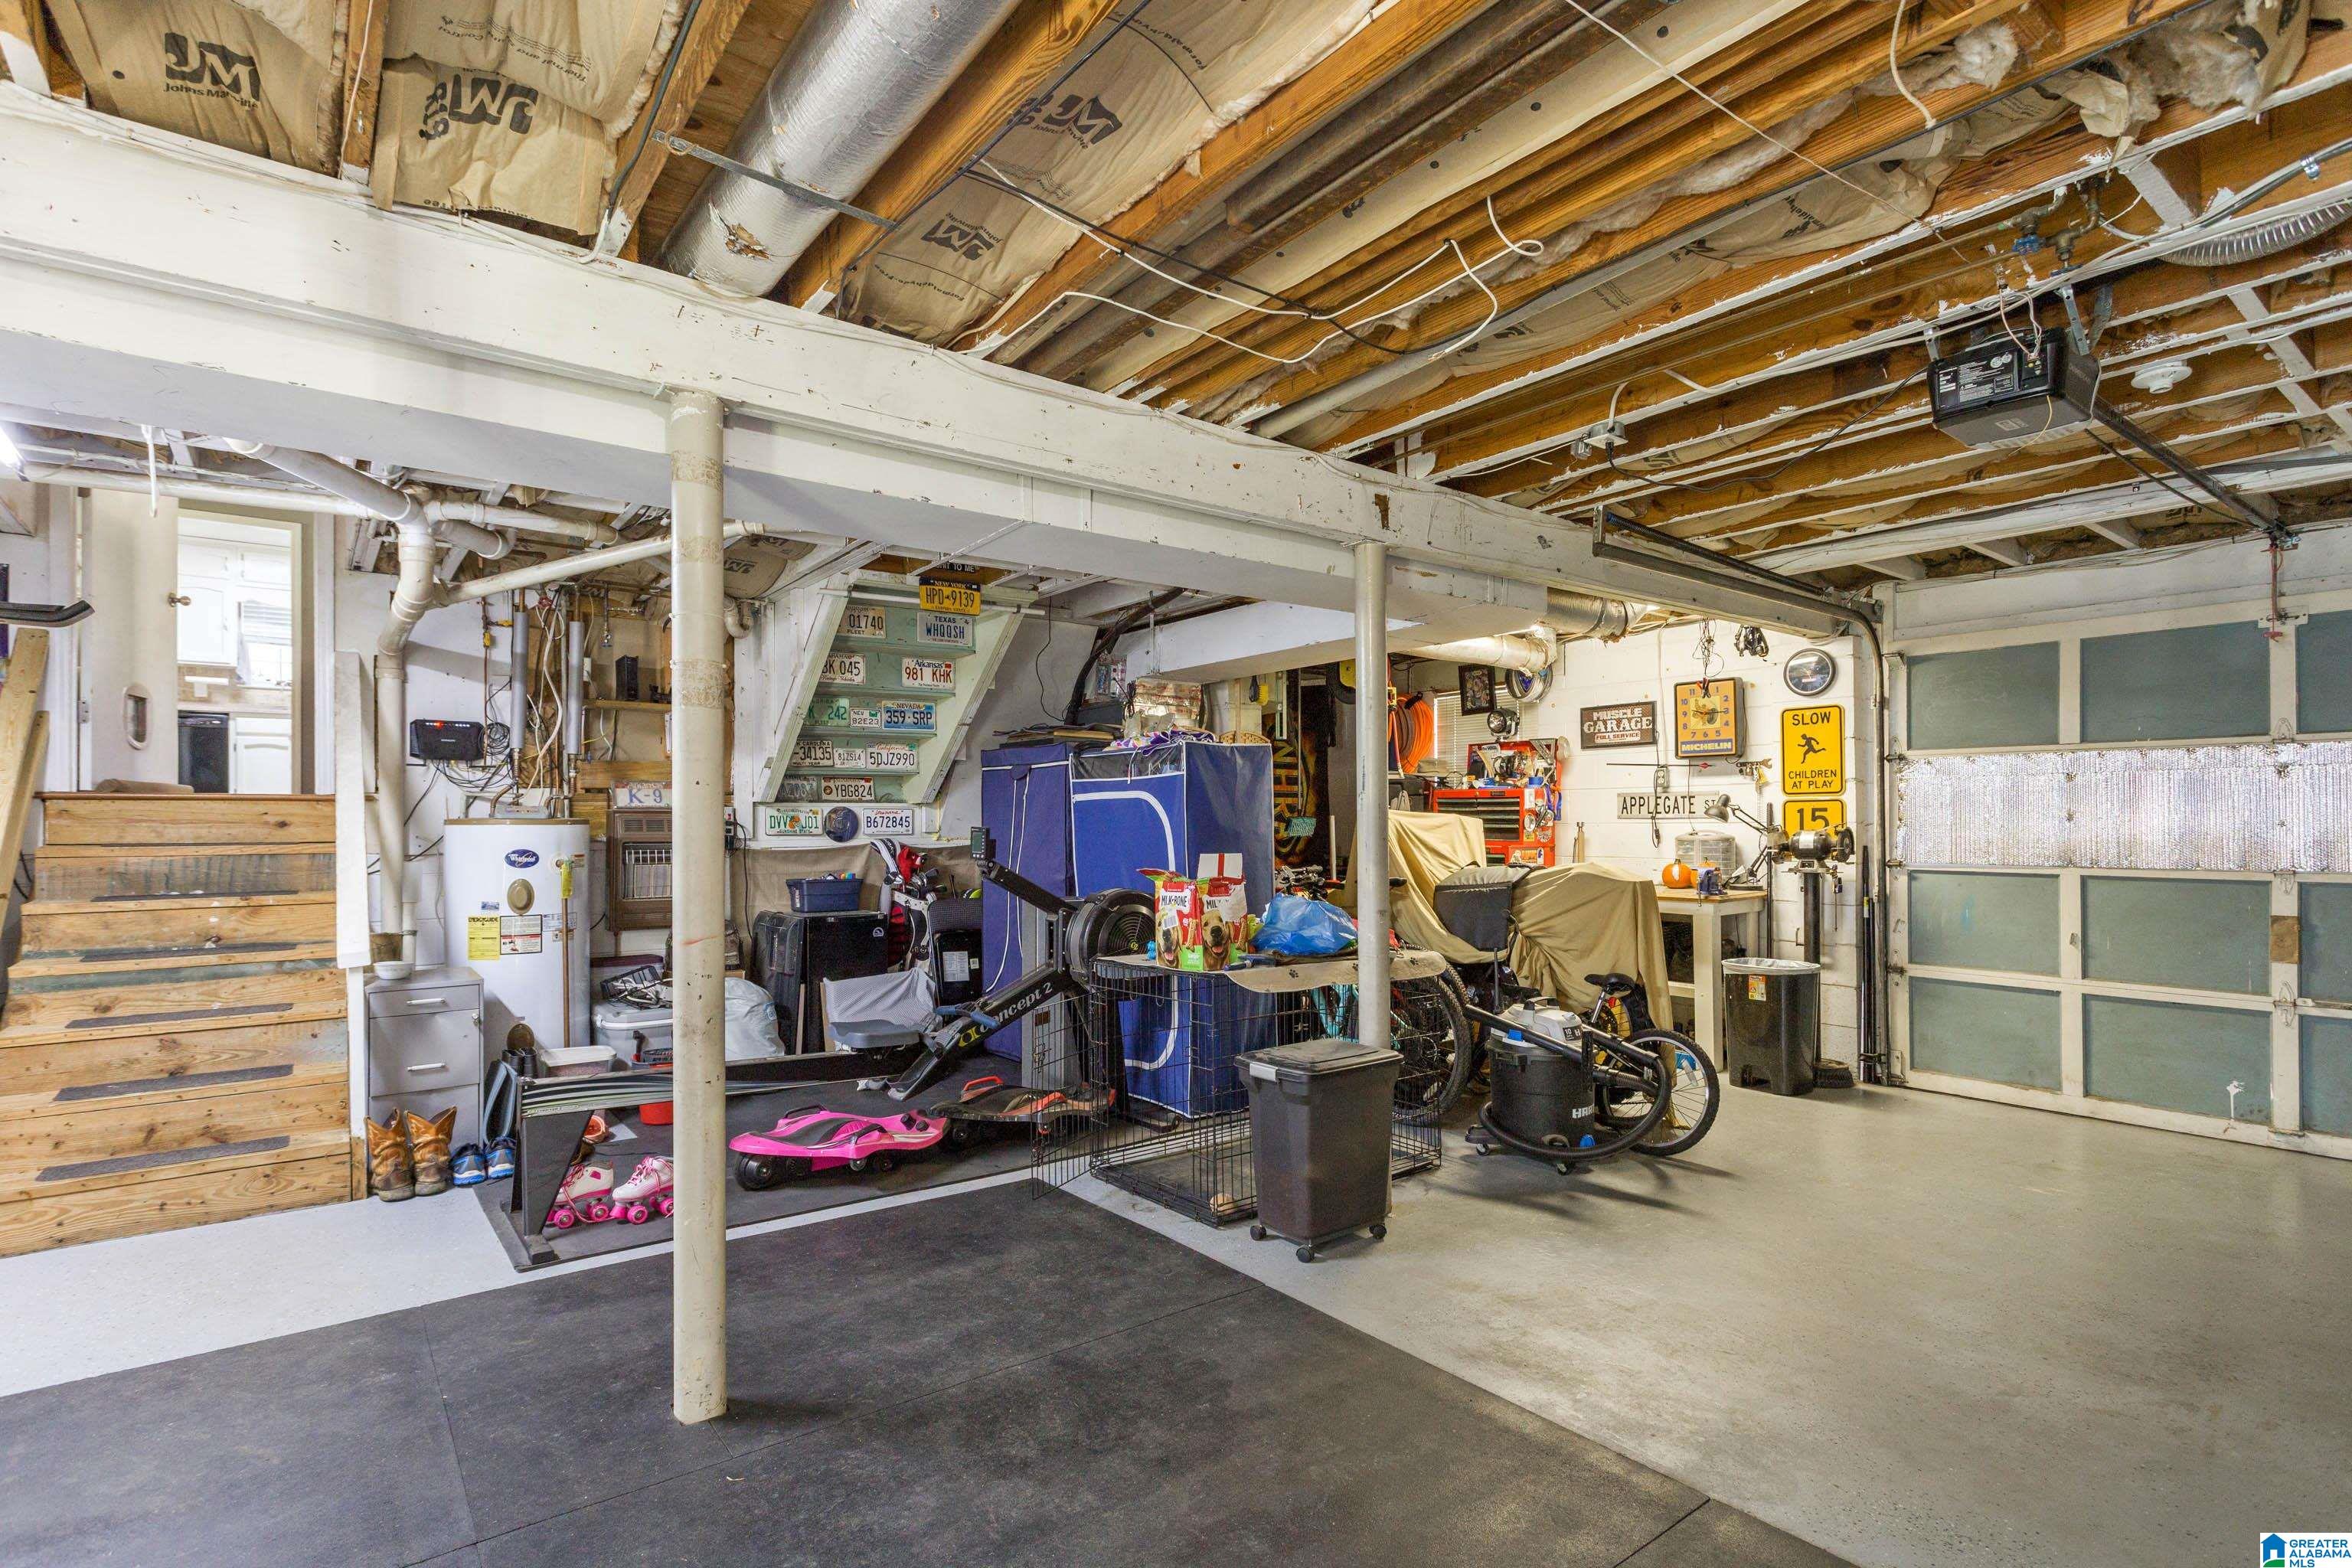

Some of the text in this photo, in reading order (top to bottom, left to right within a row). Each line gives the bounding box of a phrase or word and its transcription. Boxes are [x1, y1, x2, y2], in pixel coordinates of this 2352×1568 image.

[165, 32, 260, 101] JM
[163, 82, 204, 96] Johns
[965, 564, 975, 573] ME
[848, 613, 884, 630] 01740
[935, 616, 956, 624] TEXAS
[839, 660, 861, 676] 045
[915, 659, 943, 669] Arkansas
[905, 666, 952, 684] 981 KHK
[828, 705, 847, 720] 242
[1592, 707, 1642, 720] MUSCLE
[1792, 711, 1831, 726] SLOW
[1583, 717, 1653, 733] GARAGE
[877, 743, 906, 752] California
[1681, 742, 1733, 751] MICHELIN
[869, 751, 915, 766] 5DJZ990
[1788, 769, 1837, 779] CHILDREN
[835, 784, 873, 798] YBG824
[1792, 779, 1833, 789] AT PLAY
[1621, 795, 1696, 815] APPLEGATE
[866, 816, 910, 828] B672845
[1796, 807, 1830, 831] 15
[1040, 982, 1054, 994] 2
[1572, 1105, 1593, 1119] HAR
